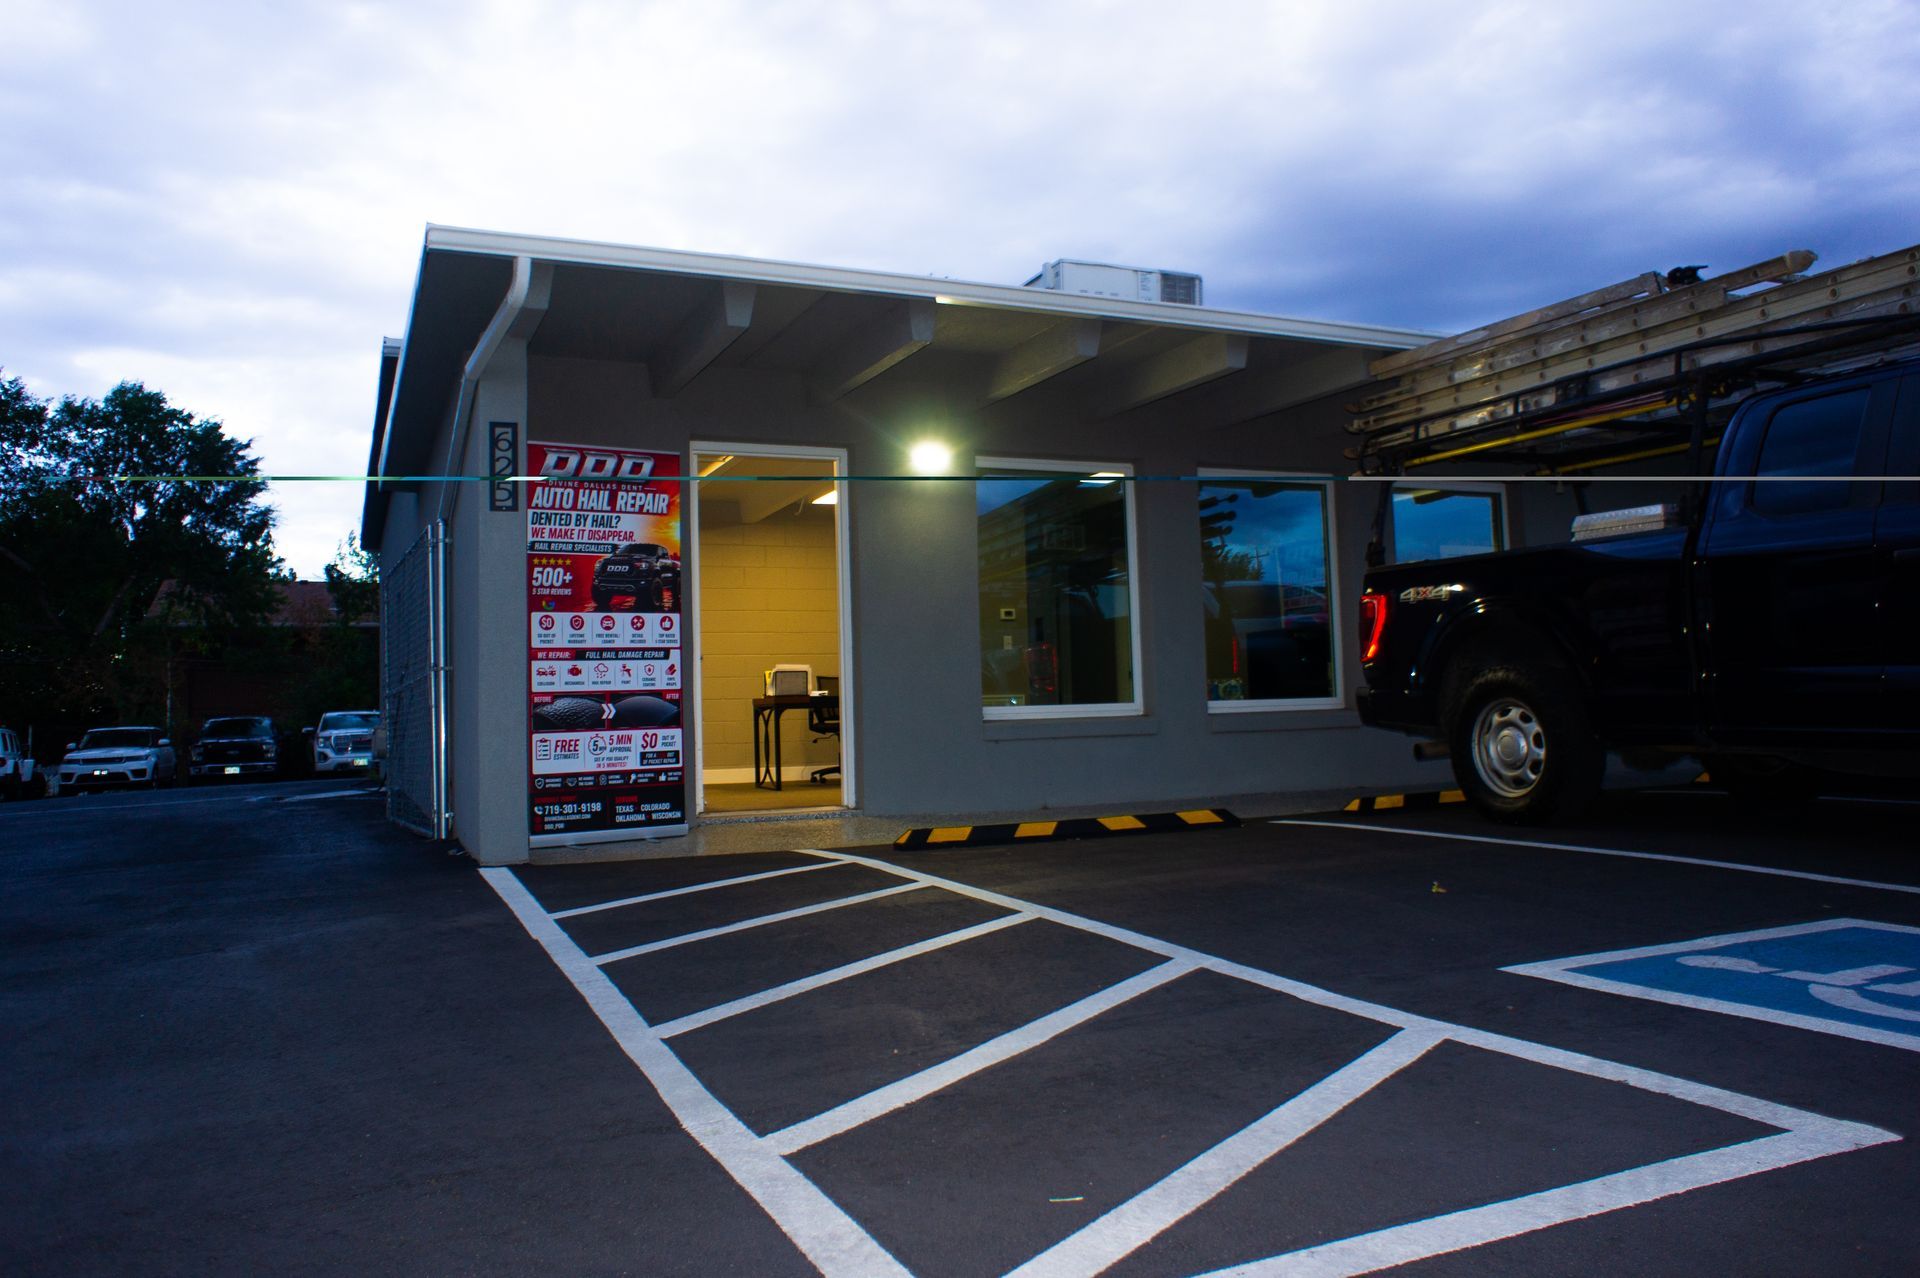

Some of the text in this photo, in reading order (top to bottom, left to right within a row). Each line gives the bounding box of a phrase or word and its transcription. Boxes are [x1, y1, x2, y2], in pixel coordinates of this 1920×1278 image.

[494, 431, 512, 502] 625
[548, 480, 579, 488] DIVINE
[584, 482, 617, 490] DALLAS
[531, 487, 669, 514] AUTO HAIL REPAIR
[531, 512, 621, 529] DENTED BY HAIL?
[531, 527, 636, 542] WE MAKE IT DISAPPEAR.
[534, 542, 612, 552] HAIL REPAIR SPECIALISTS
[532, 567, 573, 587] 500+
[541, 618, 552, 628] $0
[602, 651, 616, 659] HAIL
[643, 650, 665, 658] REPAIR
[554, 738, 580, 753] FREE
[592, 740, 599, 751] 5
[608, 734, 633, 746] 5 MIN
[641, 732, 658, 750] $0
[544, 802, 602, 815] 719-301-9198
[615, 803, 670, 813] TEXAS COLORADO
[615, 811, 682, 823] OKLAHOMA WISCONSIN
